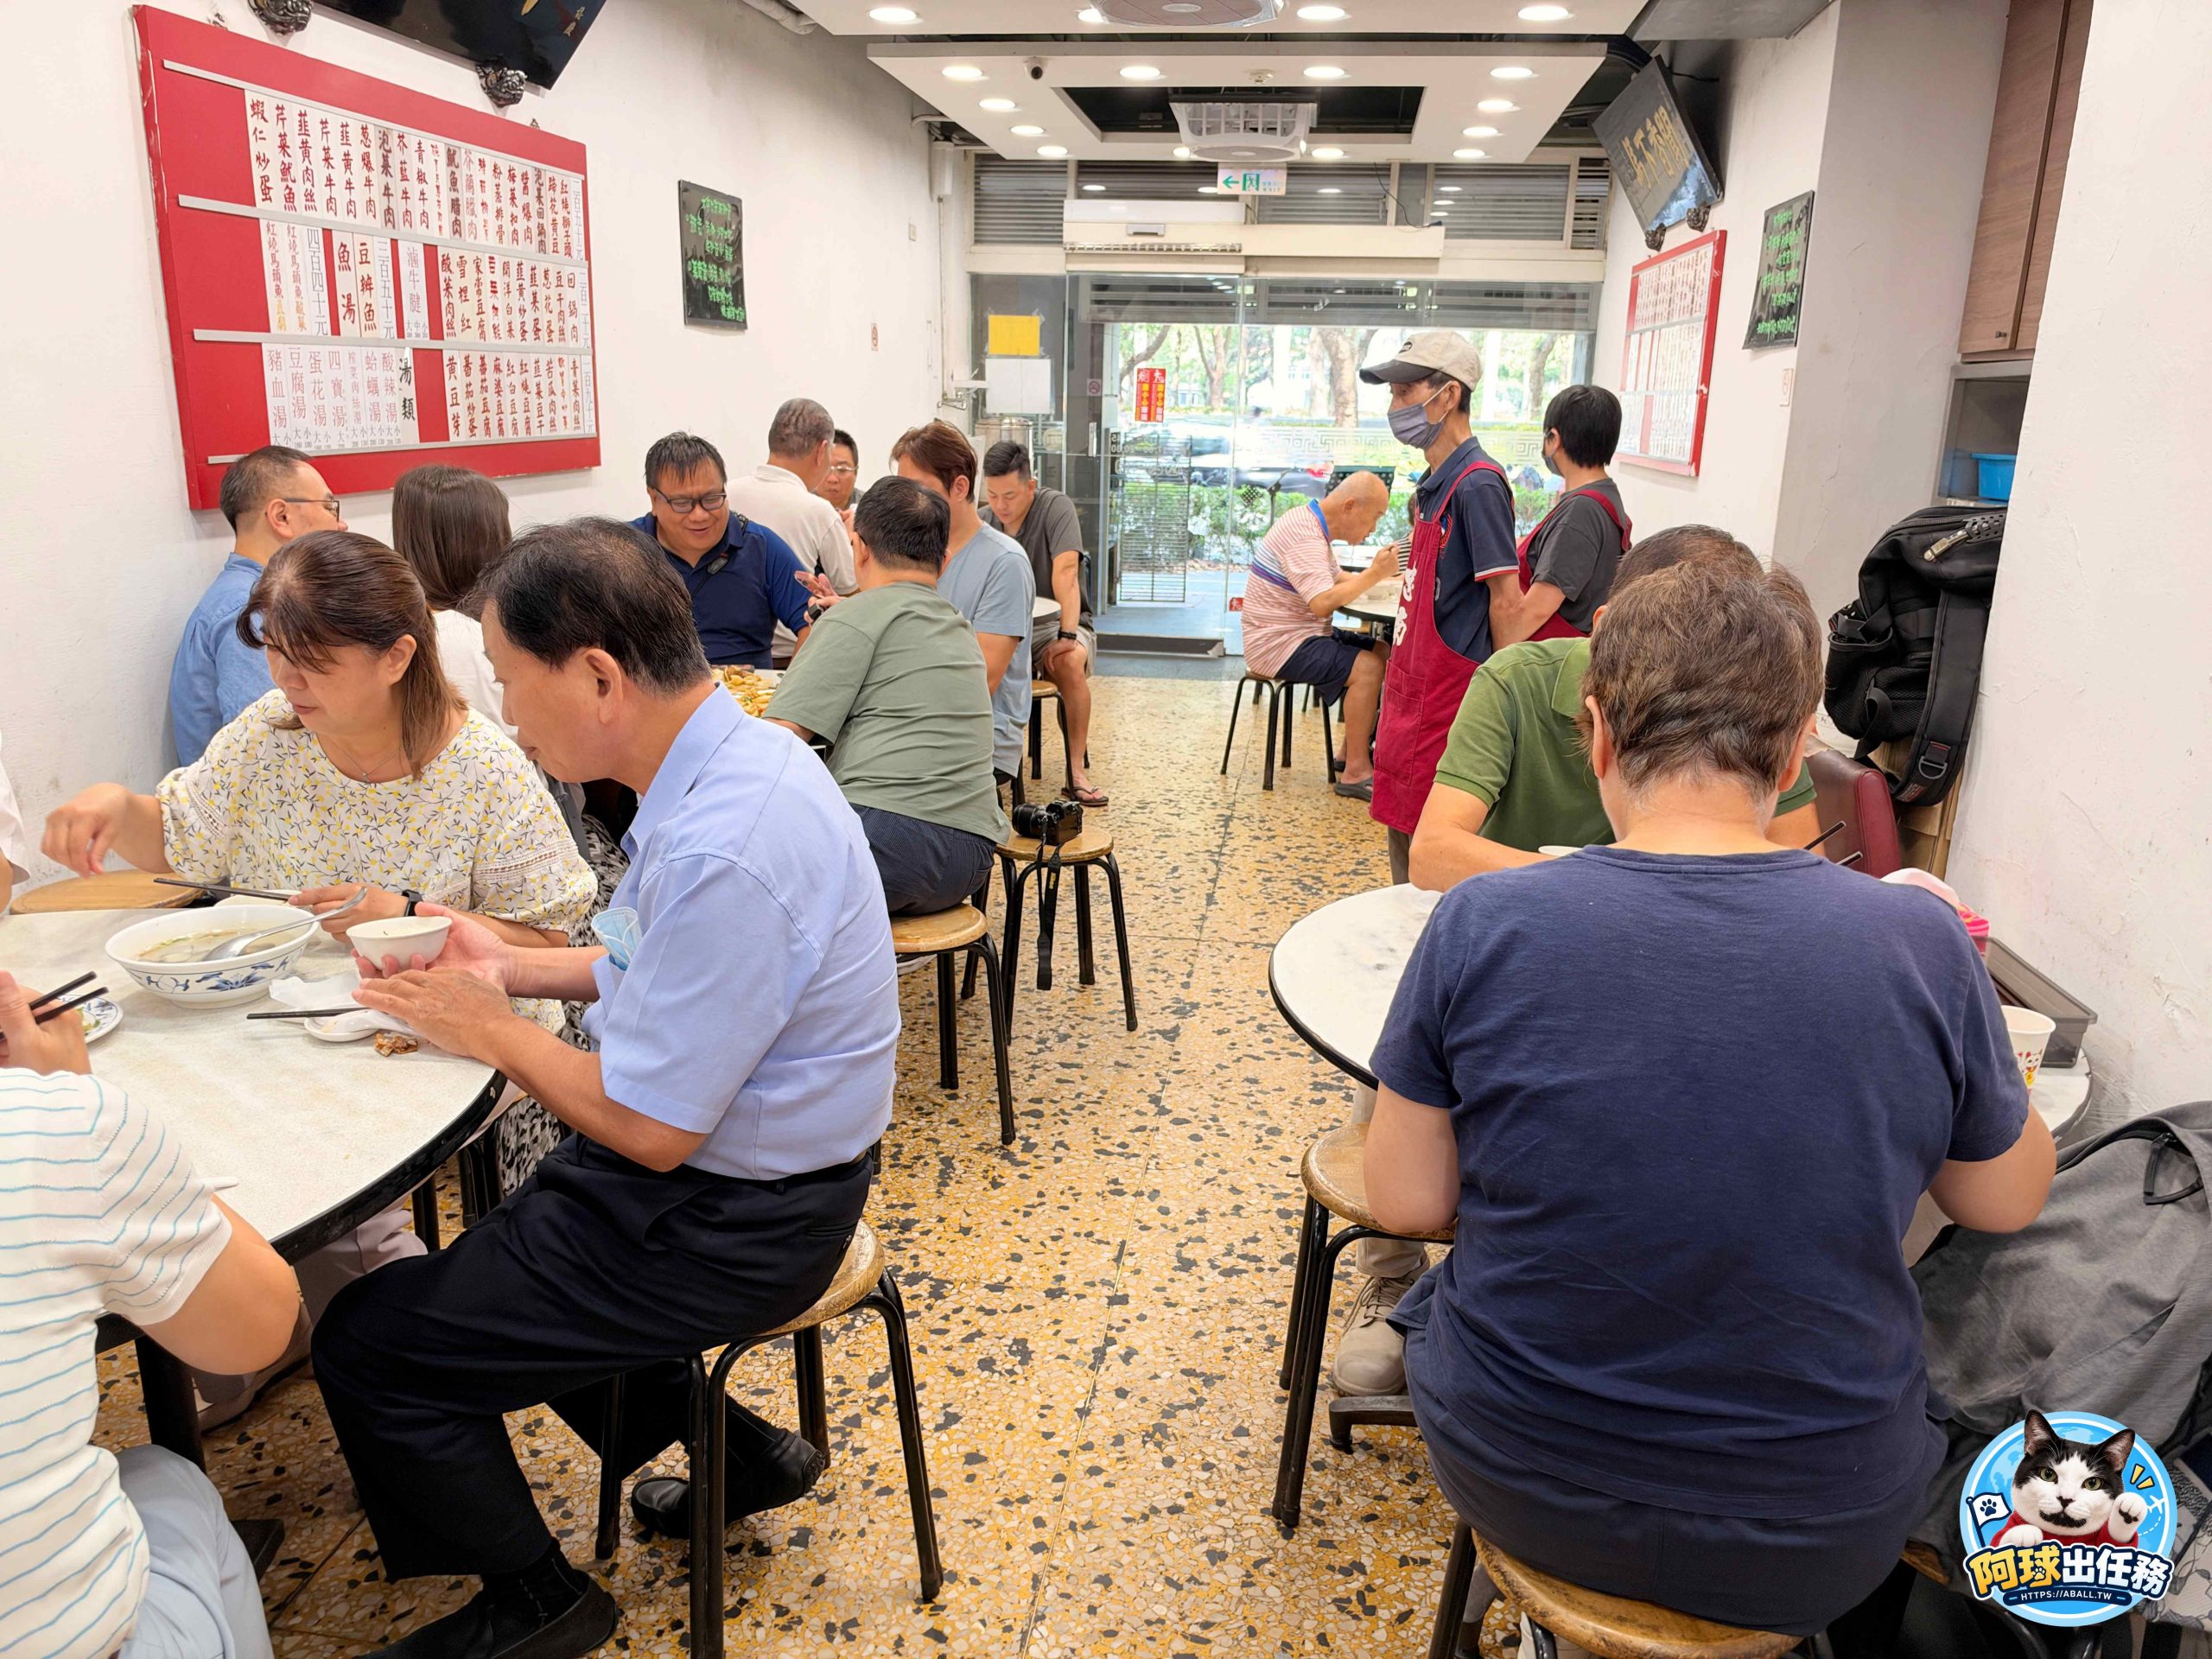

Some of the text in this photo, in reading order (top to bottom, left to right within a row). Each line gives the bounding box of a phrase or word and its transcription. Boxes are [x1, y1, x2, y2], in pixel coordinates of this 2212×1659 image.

[251, 99, 274, 203] 蝦仁炒蛋
[275, 104, 297, 213] 芹菜魷魚
[320, 118, 338, 216] 芹菜牛肉
[378, 130, 396, 230] 泡菜牛肉
[415, 140, 429, 230] 青椒牛肉
[493, 162, 505, 245] 粉蒸排骨
[507, 164, 518, 245] 梅菜扣肉
[535, 167, 546, 254] 泡菜回鍋肉
[560, 180, 573, 259] 紅燒獅子頭
[573, 181, 584, 261] 二百五十元
[308, 228, 328, 336] 四百四十元
[338, 242, 356, 325] 魚湯
[377, 240, 395, 339] 三百五十元
[441, 252, 456, 338] 酸菜肉絲
[474, 256, 486, 342] 家常豆腐
[555, 271, 566, 342] 豆干肉絲
[567, 273, 579, 343] 回鍋肉
[268, 349, 287, 429] 豬血湯
[289, 347, 306, 420] 豆腐湯
[309, 351, 327, 428] 蛋花湯
[328, 351, 346, 428] 四寶湯
[365, 351, 380, 423] 蛤蠣湯
[382, 353, 397, 423] 酸辣湯
[399, 358, 416, 421] 湯類
[446, 355, 461, 437] 黃豆芽
[493, 357, 505, 437] 麻婆豆腐
[520, 359, 531, 436] 紅燒豆腐
[546, 356, 556, 433] 苦瓜肉絲
[570, 358, 581, 431] 青菜肉絲
